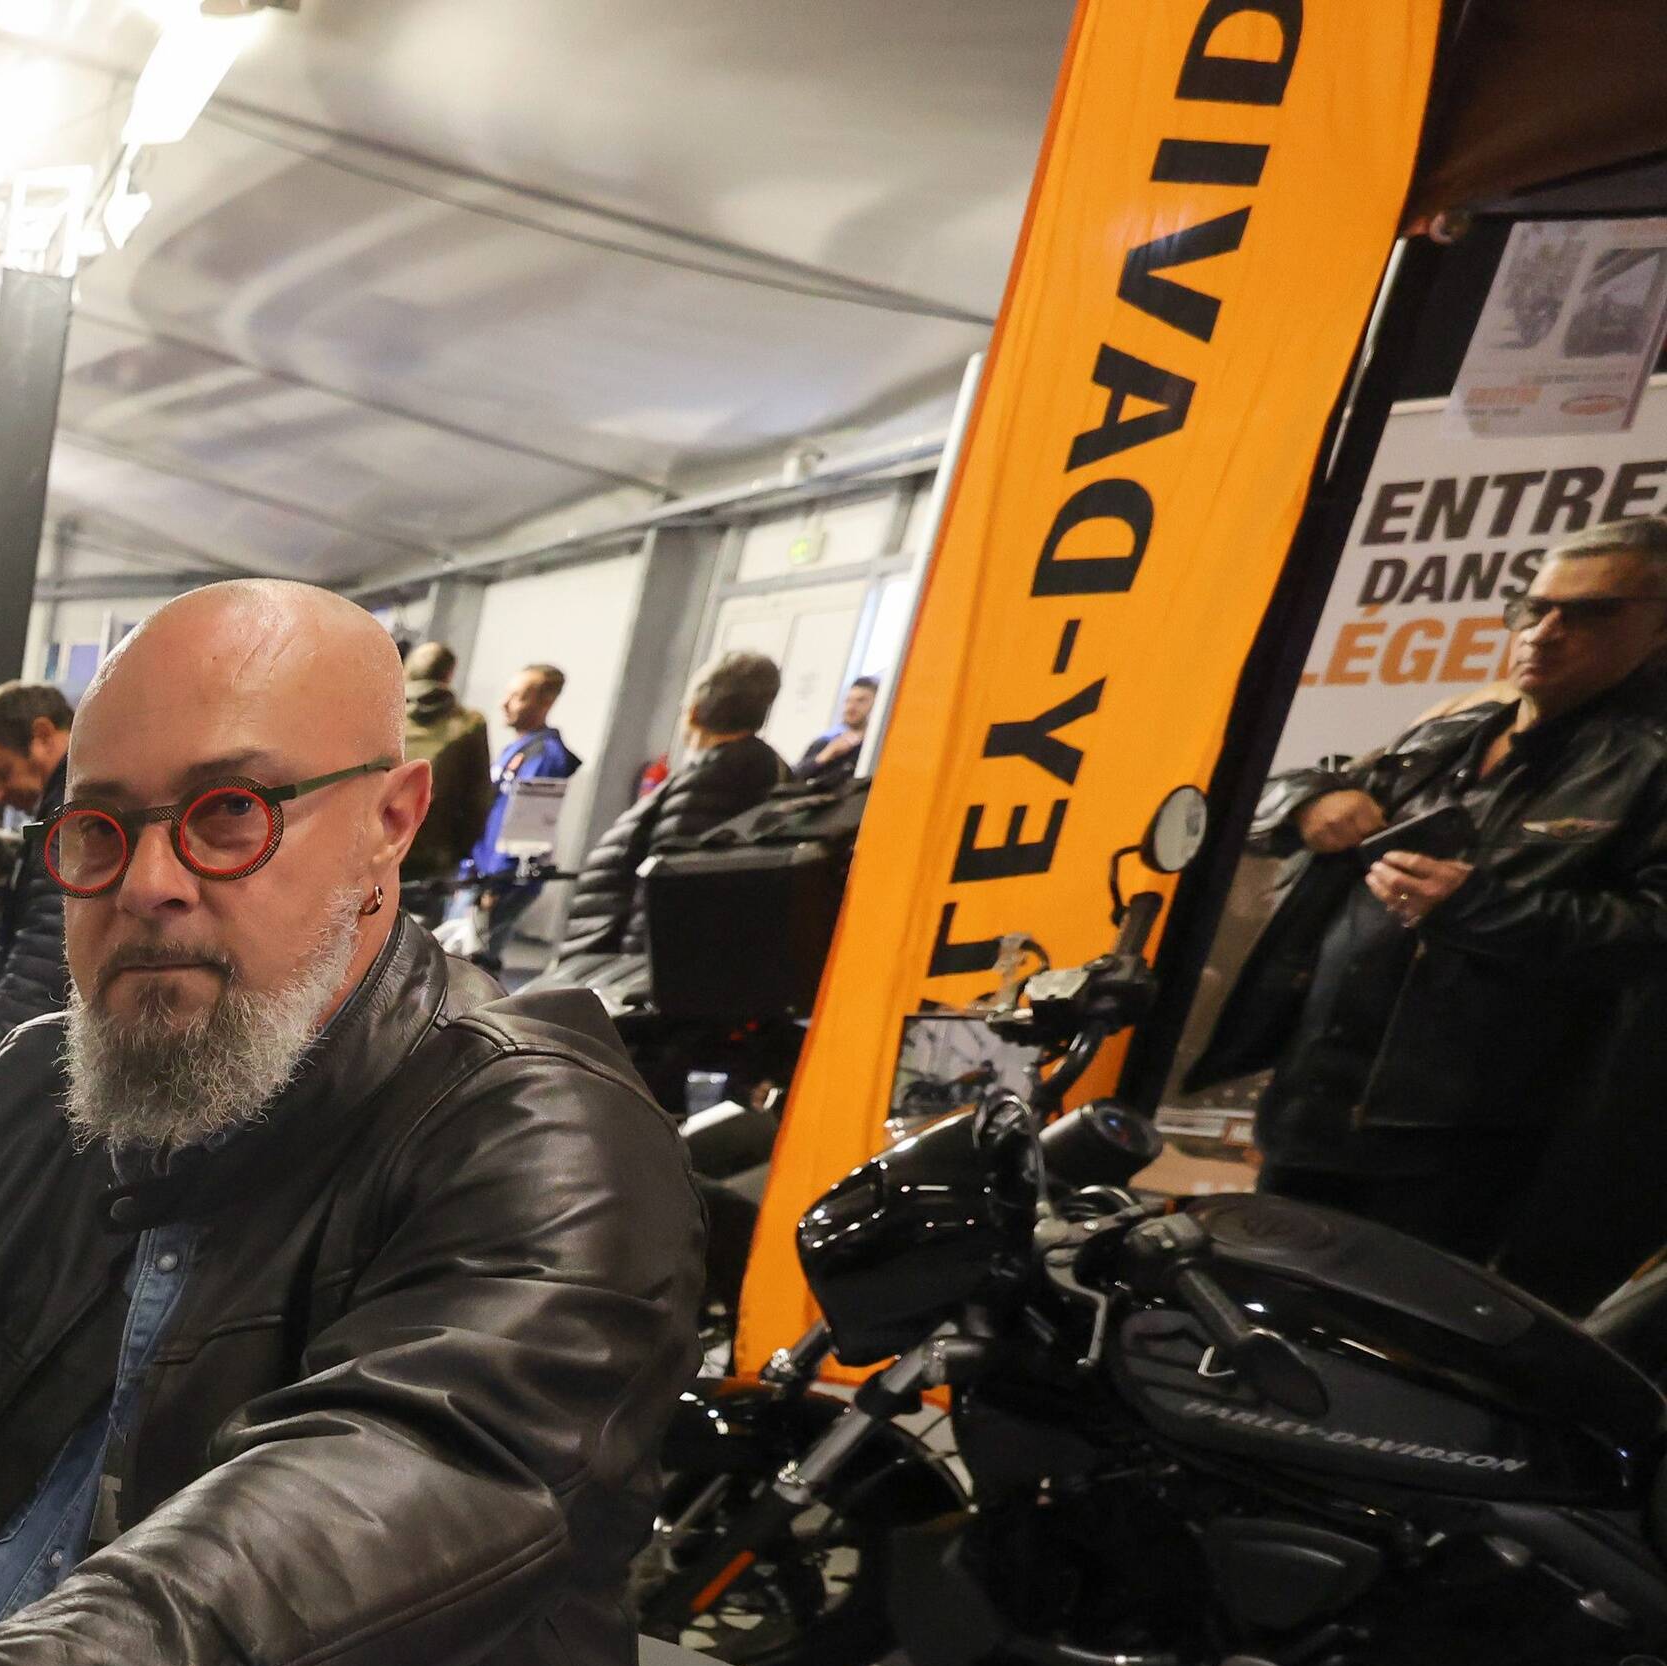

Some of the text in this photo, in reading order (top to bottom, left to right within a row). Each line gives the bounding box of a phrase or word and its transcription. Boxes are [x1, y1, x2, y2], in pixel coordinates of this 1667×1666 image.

[1360, 459, 1667, 547] ENTRE
[1355, 548, 1550, 608] DANS
[1300, 604, 1514, 688] ÉGE
[1183, 1400, 1528, 1473] HARLEY-DAVIDSON
